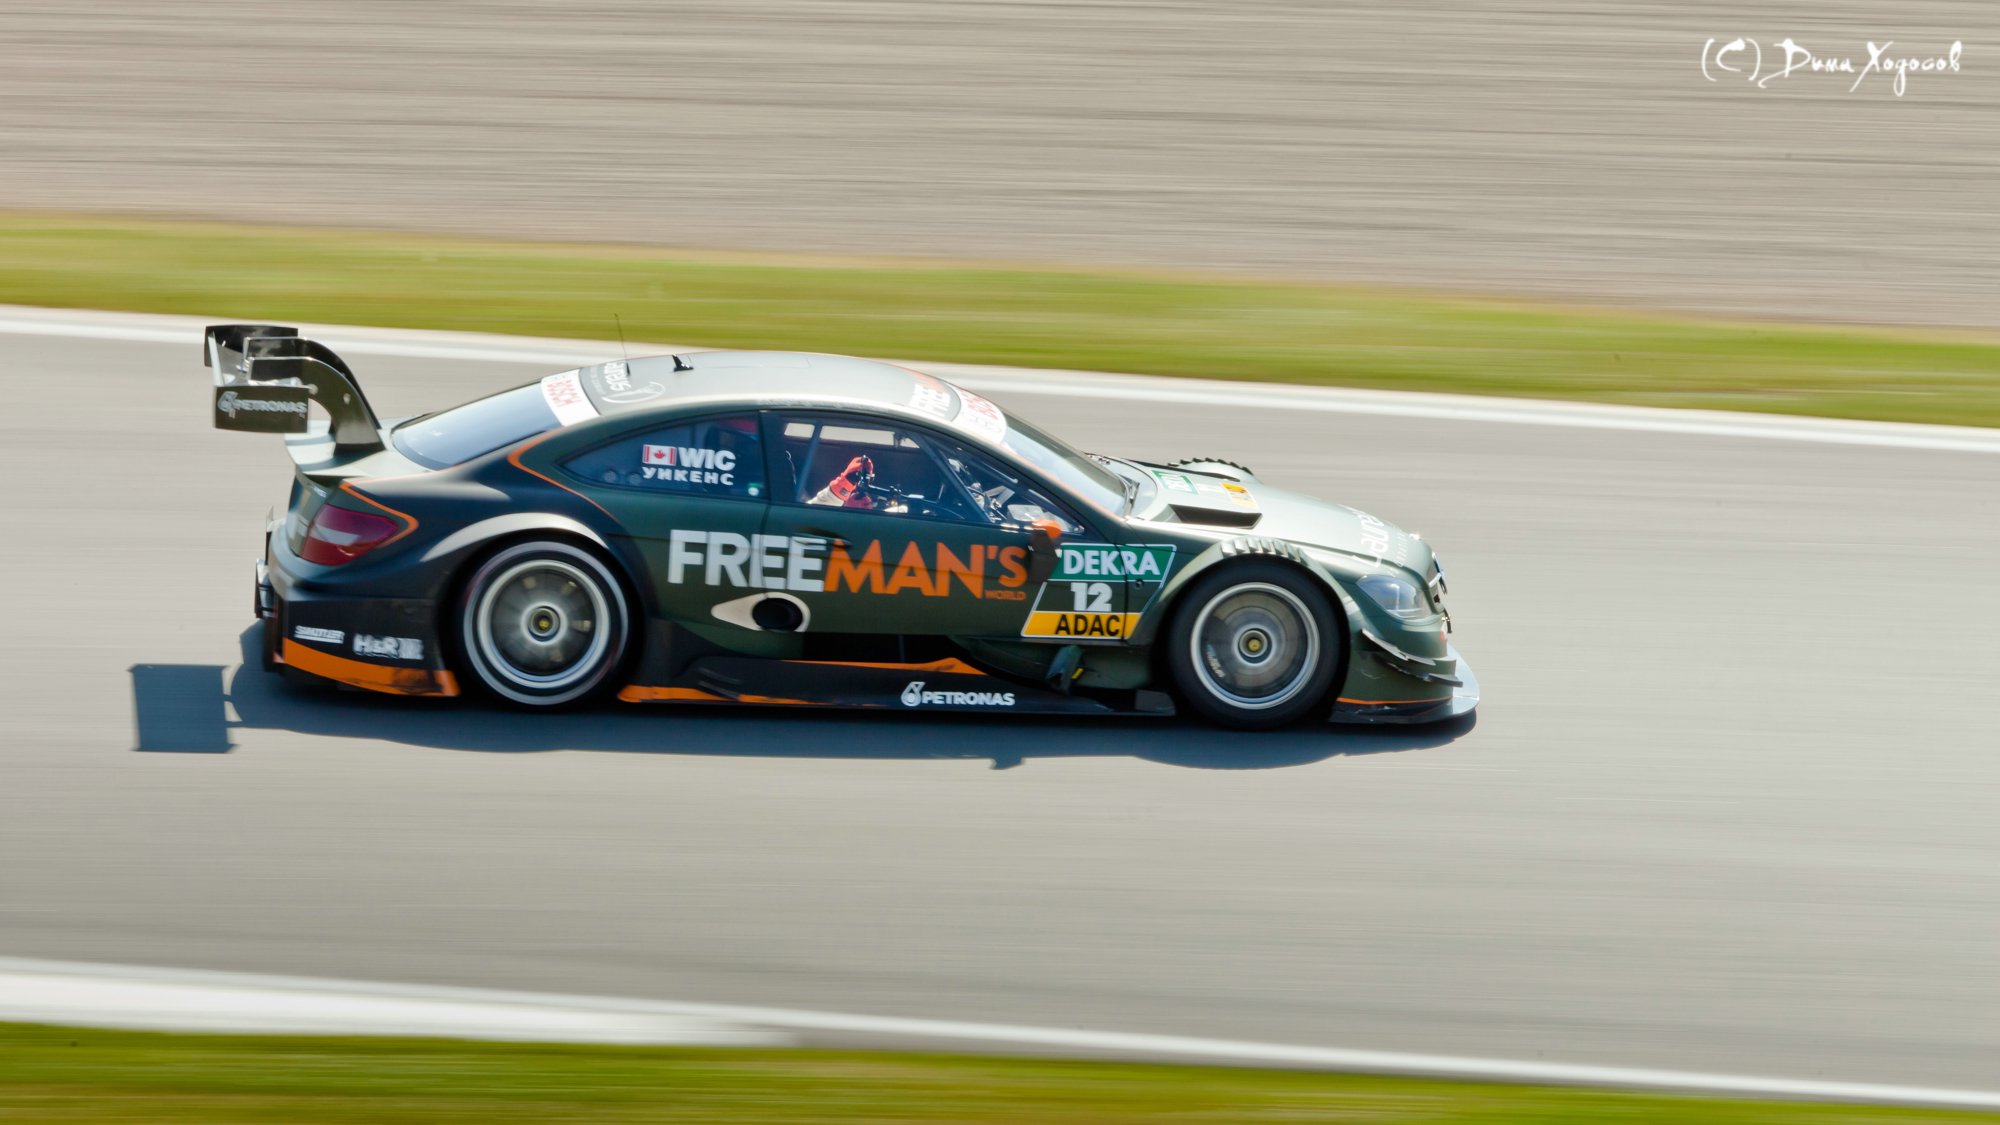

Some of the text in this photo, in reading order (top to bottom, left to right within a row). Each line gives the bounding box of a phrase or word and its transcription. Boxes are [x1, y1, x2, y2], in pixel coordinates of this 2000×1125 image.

[232, 399, 308, 414] PETRONAS
[678, 446, 736, 472] WIC
[668, 529, 1028, 599] FREEMAN'S
[1063, 549, 1160, 576] DEKRA
[1071, 582, 1113, 612] 12
[1055, 614, 1121, 637] ADAC
[921, 691, 1016, 707] PETRONAS
